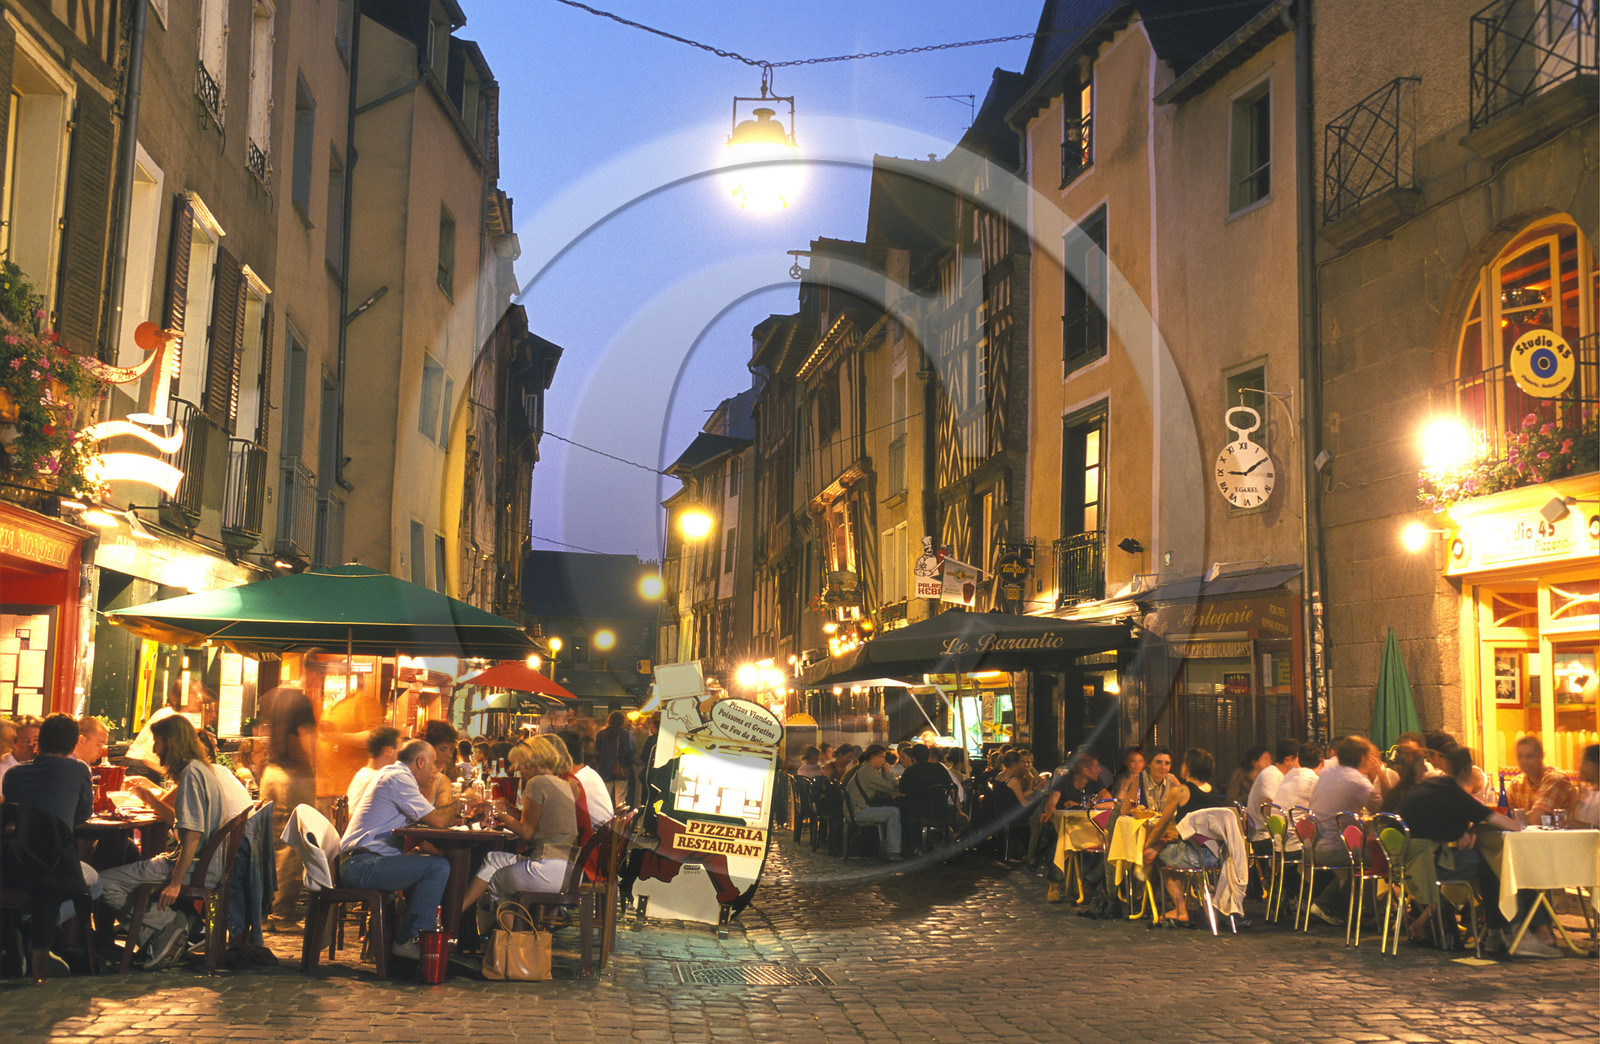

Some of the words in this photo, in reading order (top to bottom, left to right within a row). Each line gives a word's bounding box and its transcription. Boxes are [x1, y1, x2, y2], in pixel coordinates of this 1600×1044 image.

[1515, 335, 1553, 355] Studio
[1556, 344, 1571, 359] 45
[17, 532, 68, 566] MONDELLO
[1535, 537, 1570, 553] Pizzeria
[1177, 604, 1254, 632] Horlogerie
[940, 637, 970, 656] Le
[718, 708, 745, 725] Poissons
[744, 721, 752, 729] et
[752, 724, 776, 739] Gratins
[729, 701, 748, 715] Pizzas
[749, 709, 773, 726] Viandes
[729, 725, 742, 736] Feu
[741, 731, 750, 740] de
[688, 822, 764, 842] PIZZERIA
[677, 836, 762, 857] RESTAURANT
